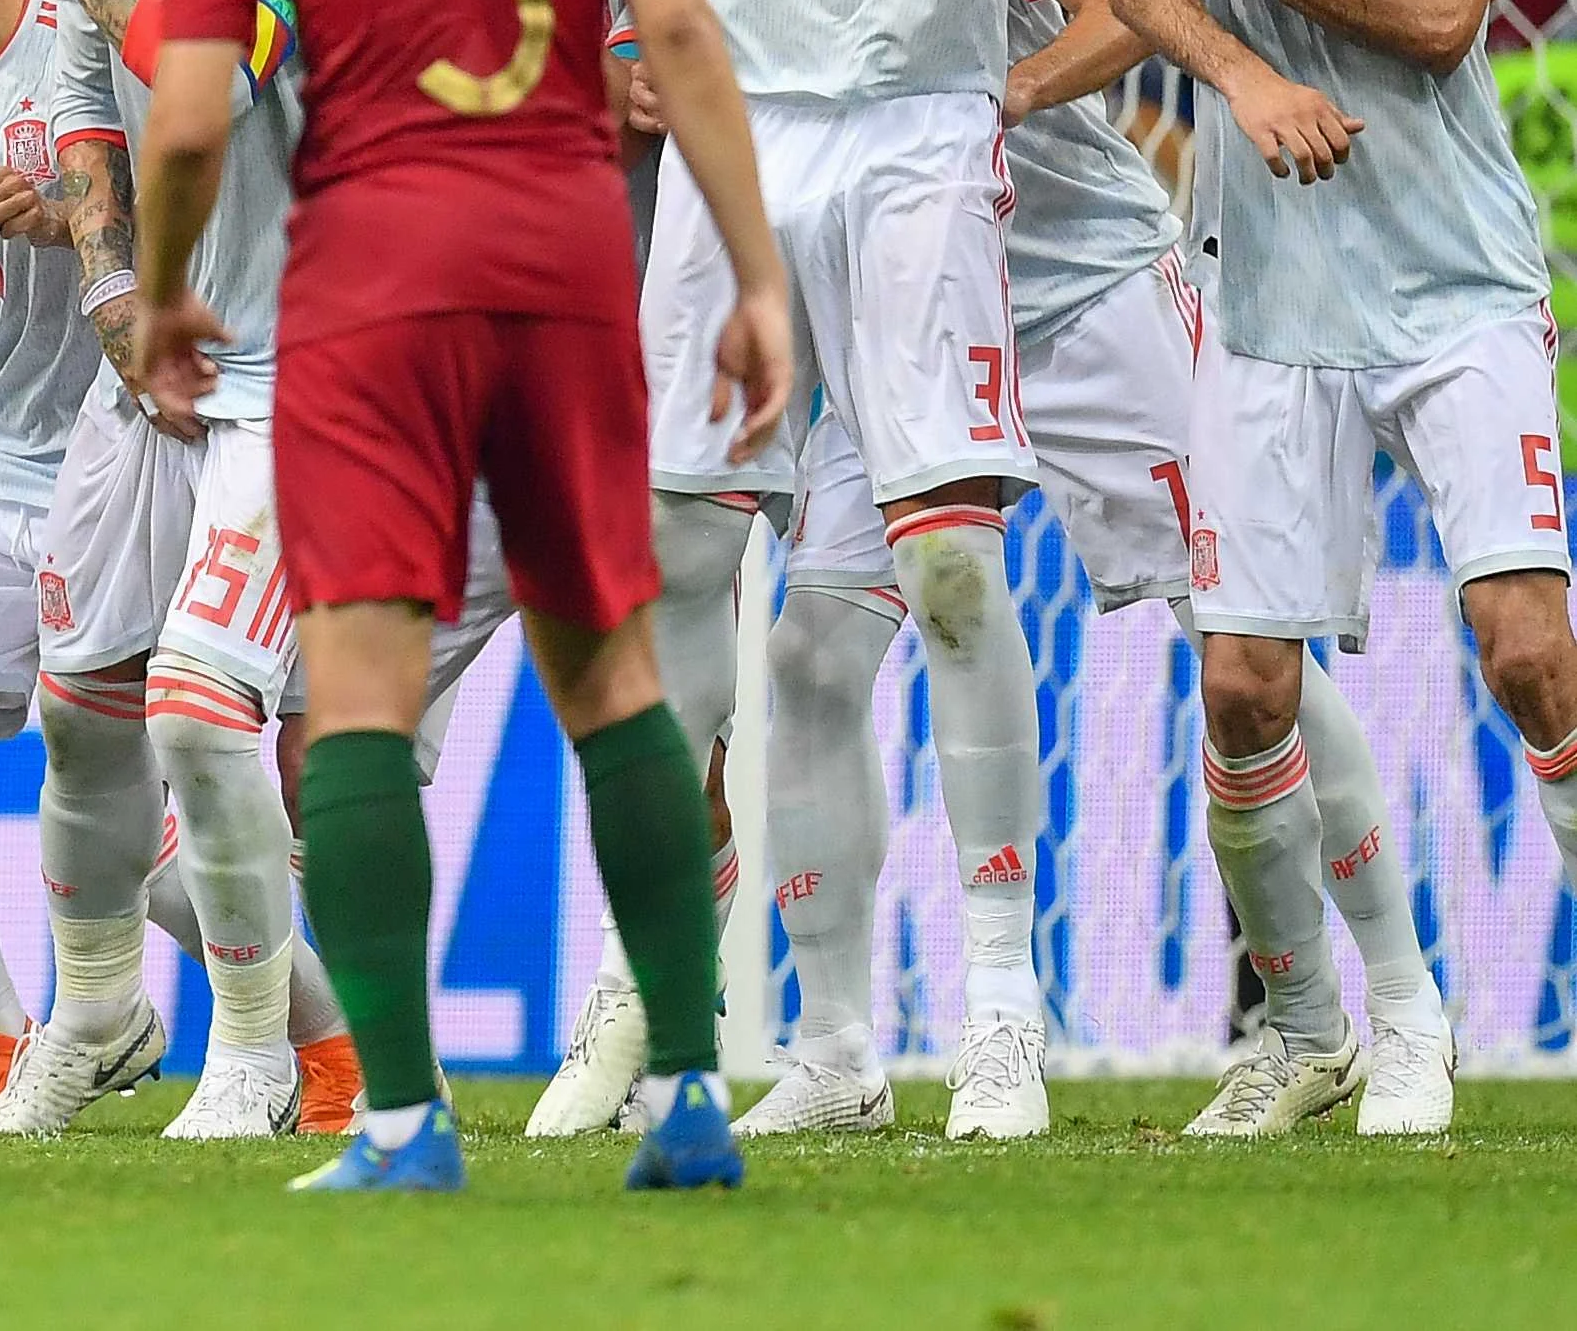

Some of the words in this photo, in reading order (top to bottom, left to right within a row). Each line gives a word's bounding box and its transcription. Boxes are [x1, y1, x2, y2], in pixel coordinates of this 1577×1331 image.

[967, 345, 1006, 442] 3
[1519, 433, 1563, 533] 5
[175, 525, 261, 629] 15
[973, 868, 1028, 885] adidas
[1330, 825, 1381, 880] RFEF
[775, 872, 824, 911] FEF
